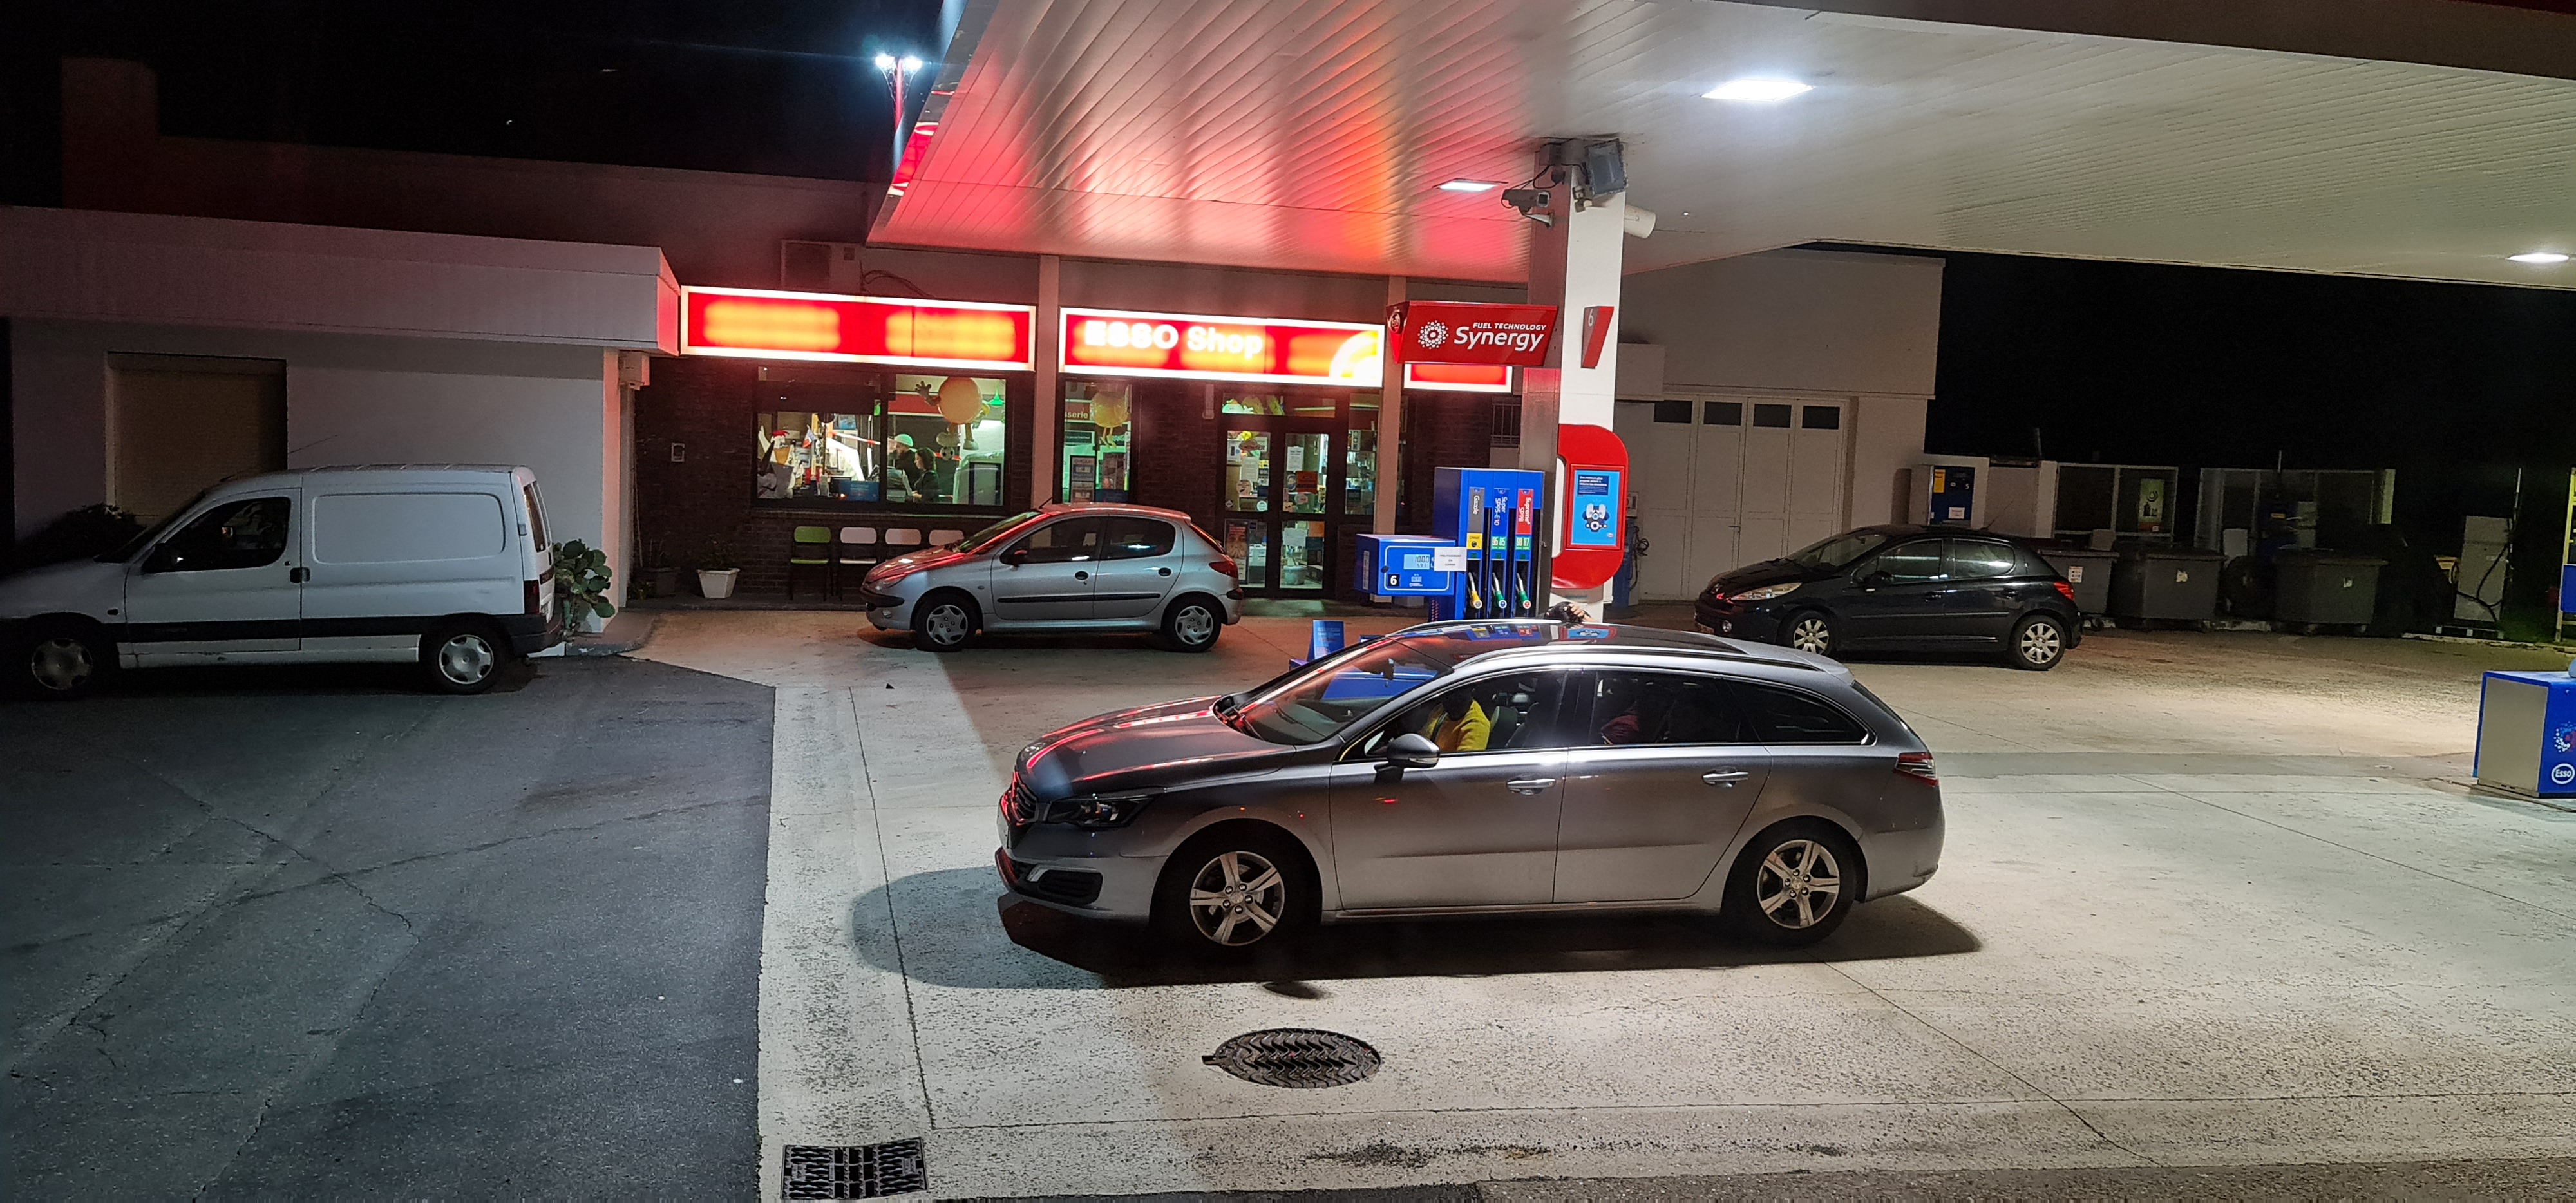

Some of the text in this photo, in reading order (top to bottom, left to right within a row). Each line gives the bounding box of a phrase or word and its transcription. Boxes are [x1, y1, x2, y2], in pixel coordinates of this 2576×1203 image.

[1587, 309, 1594, 327] 6
[1085, 320, 1263, 359] ESSO Shop
[1454, 326, 1544, 351] Synergy
[1390, 575, 1397, 585] 6
[2555, 768, 2571, 778] Esso
